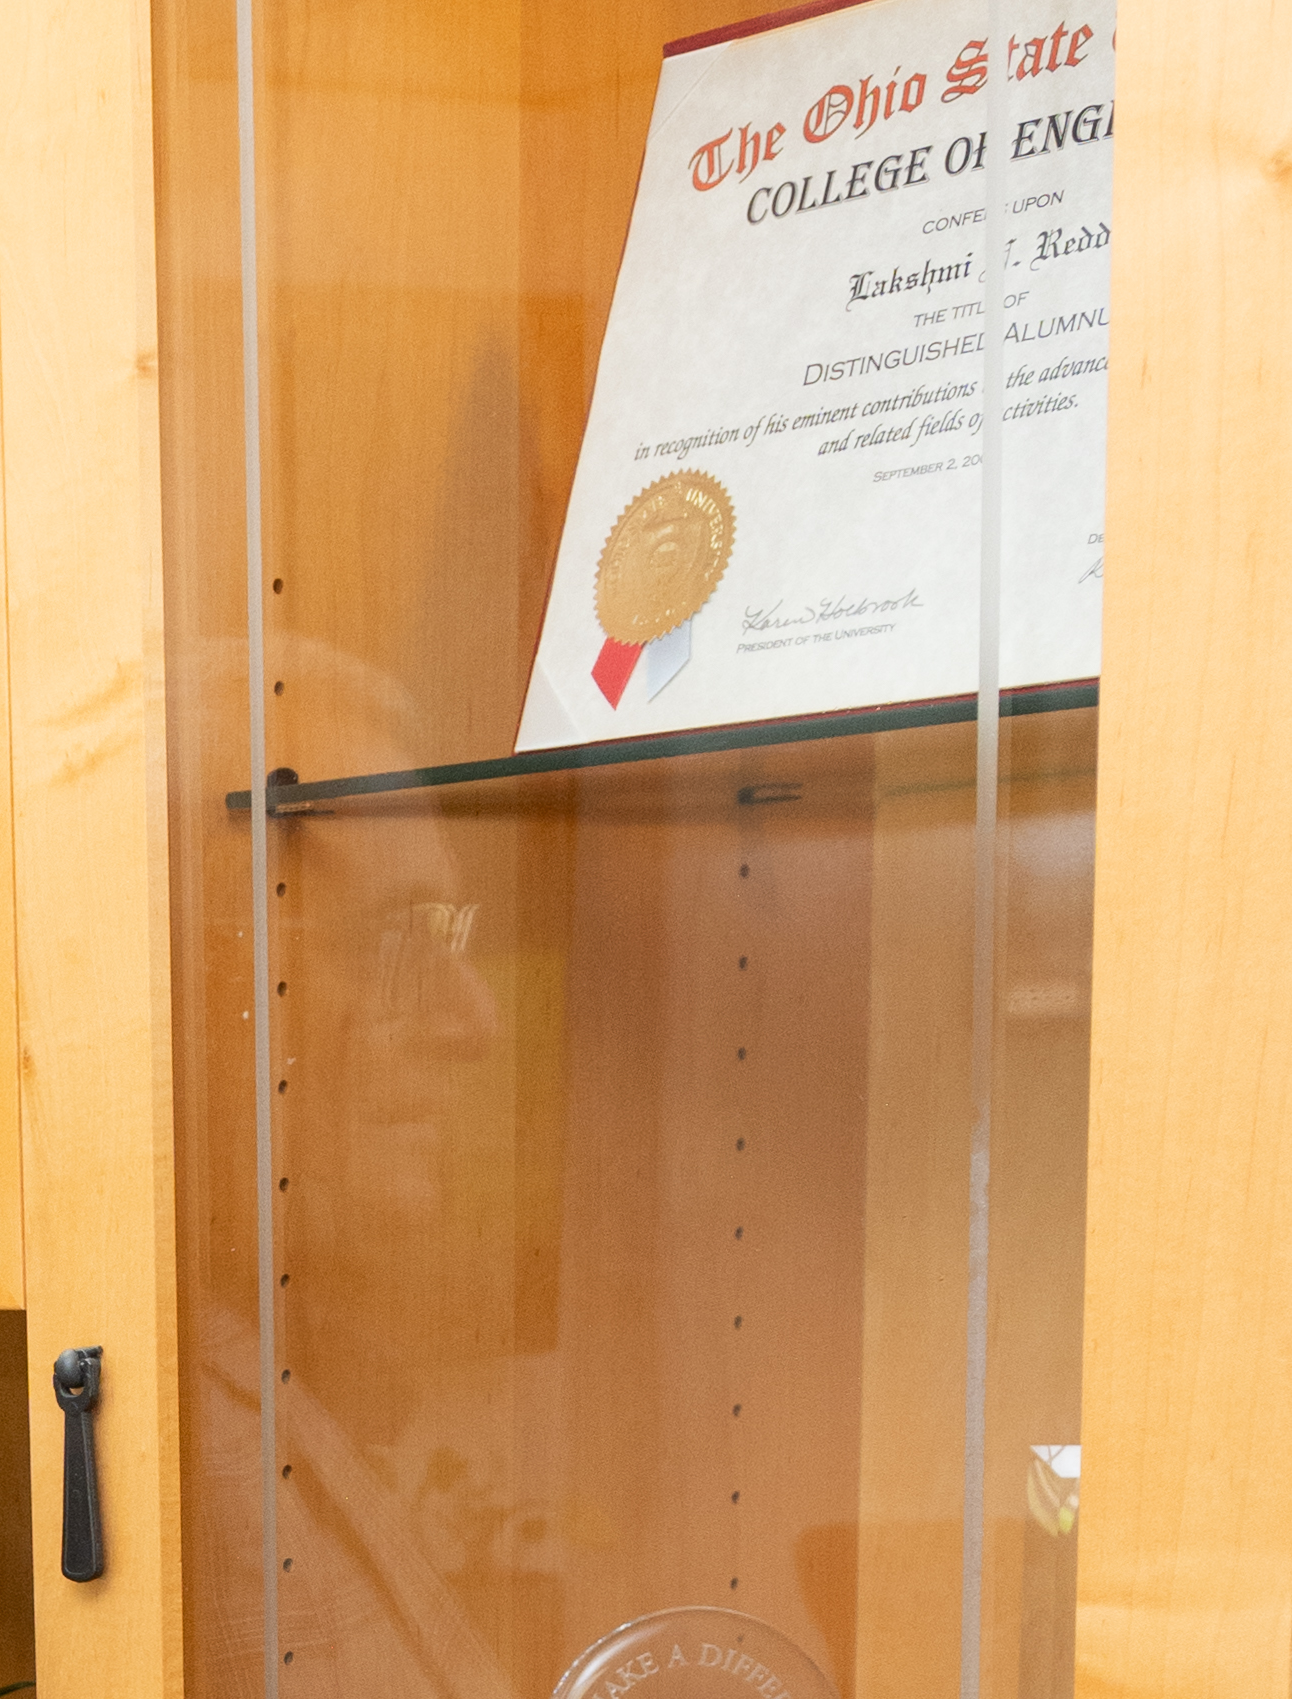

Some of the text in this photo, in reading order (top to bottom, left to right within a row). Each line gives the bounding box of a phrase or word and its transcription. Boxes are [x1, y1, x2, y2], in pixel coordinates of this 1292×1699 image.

[688, 20, 1094, 193] The Ohio State
[747, 145, 934, 225] COLLEGE
[1012, 190, 1064, 214] UPON
[846, 252, 973, 311] Lakshmi
[914, 291, 1030, 328] THE TITL OF
[633, 442, 650, 461] in
[654, 427, 740, 460] recognition
[744, 415, 767, 447] of
[764, 413, 789, 436] his
[792, 403, 859, 430] eminent
[861, 381, 978, 416] contributions
[1006, 364, 1033, 389] the
[818, 429, 854, 456] and
[854, 417, 919, 448] related
[910, 409, 963, 448] fields
[1002, 392, 1078, 422] ctivities.
[946, 458, 958, 471] 2,
[795, 636, 810, 646] OF
[813, 632, 832, 644] THE
[667, 1643, 690, 1670] A
